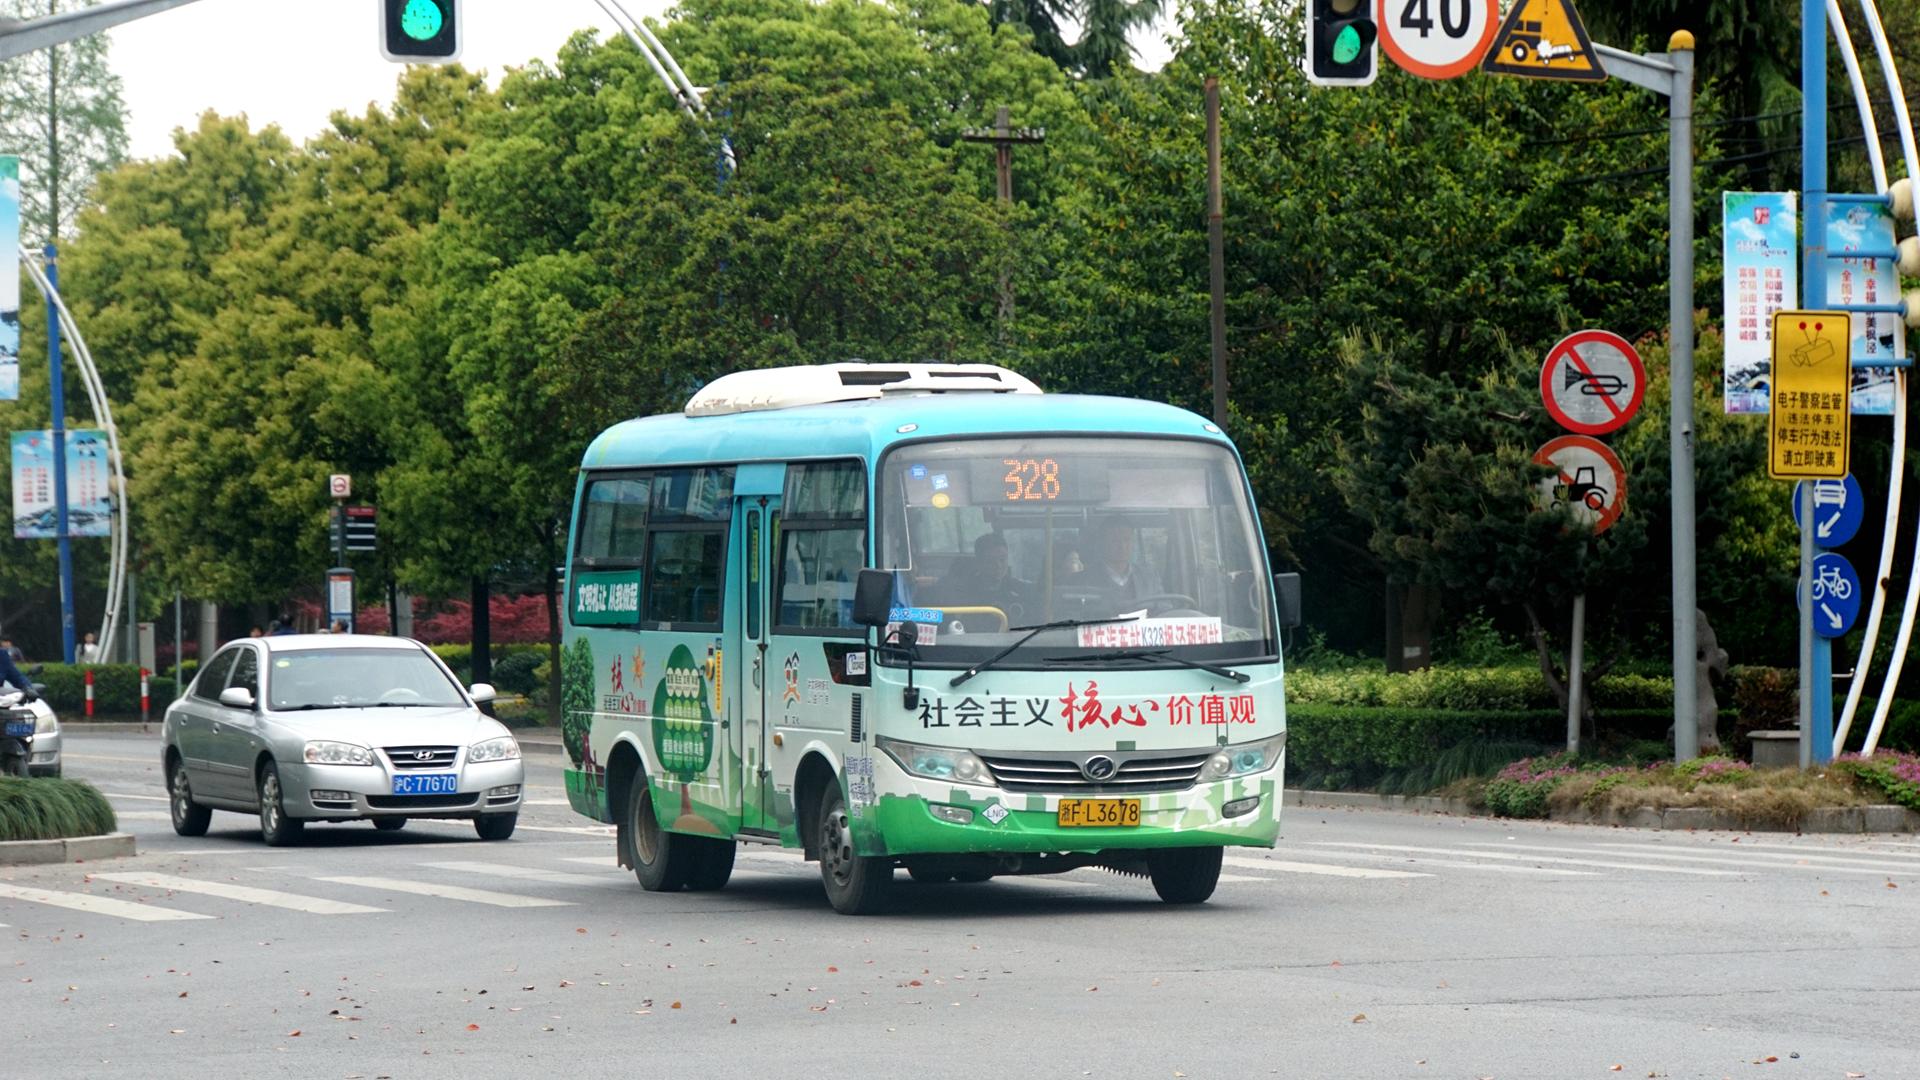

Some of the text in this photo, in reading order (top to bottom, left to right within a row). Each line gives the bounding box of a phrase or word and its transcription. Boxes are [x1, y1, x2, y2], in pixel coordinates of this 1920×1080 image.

[1400, 0, 1470, 38] 40
[1778, 392, 1841, 409] 电子警察监管
[1778, 427, 1841, 446] 停车行为违法
[1783, 450, 1836, 467] 请立即驶离
[1003, 459, 1060, 500] 328
[986, 808, 1005, 818] LNG
